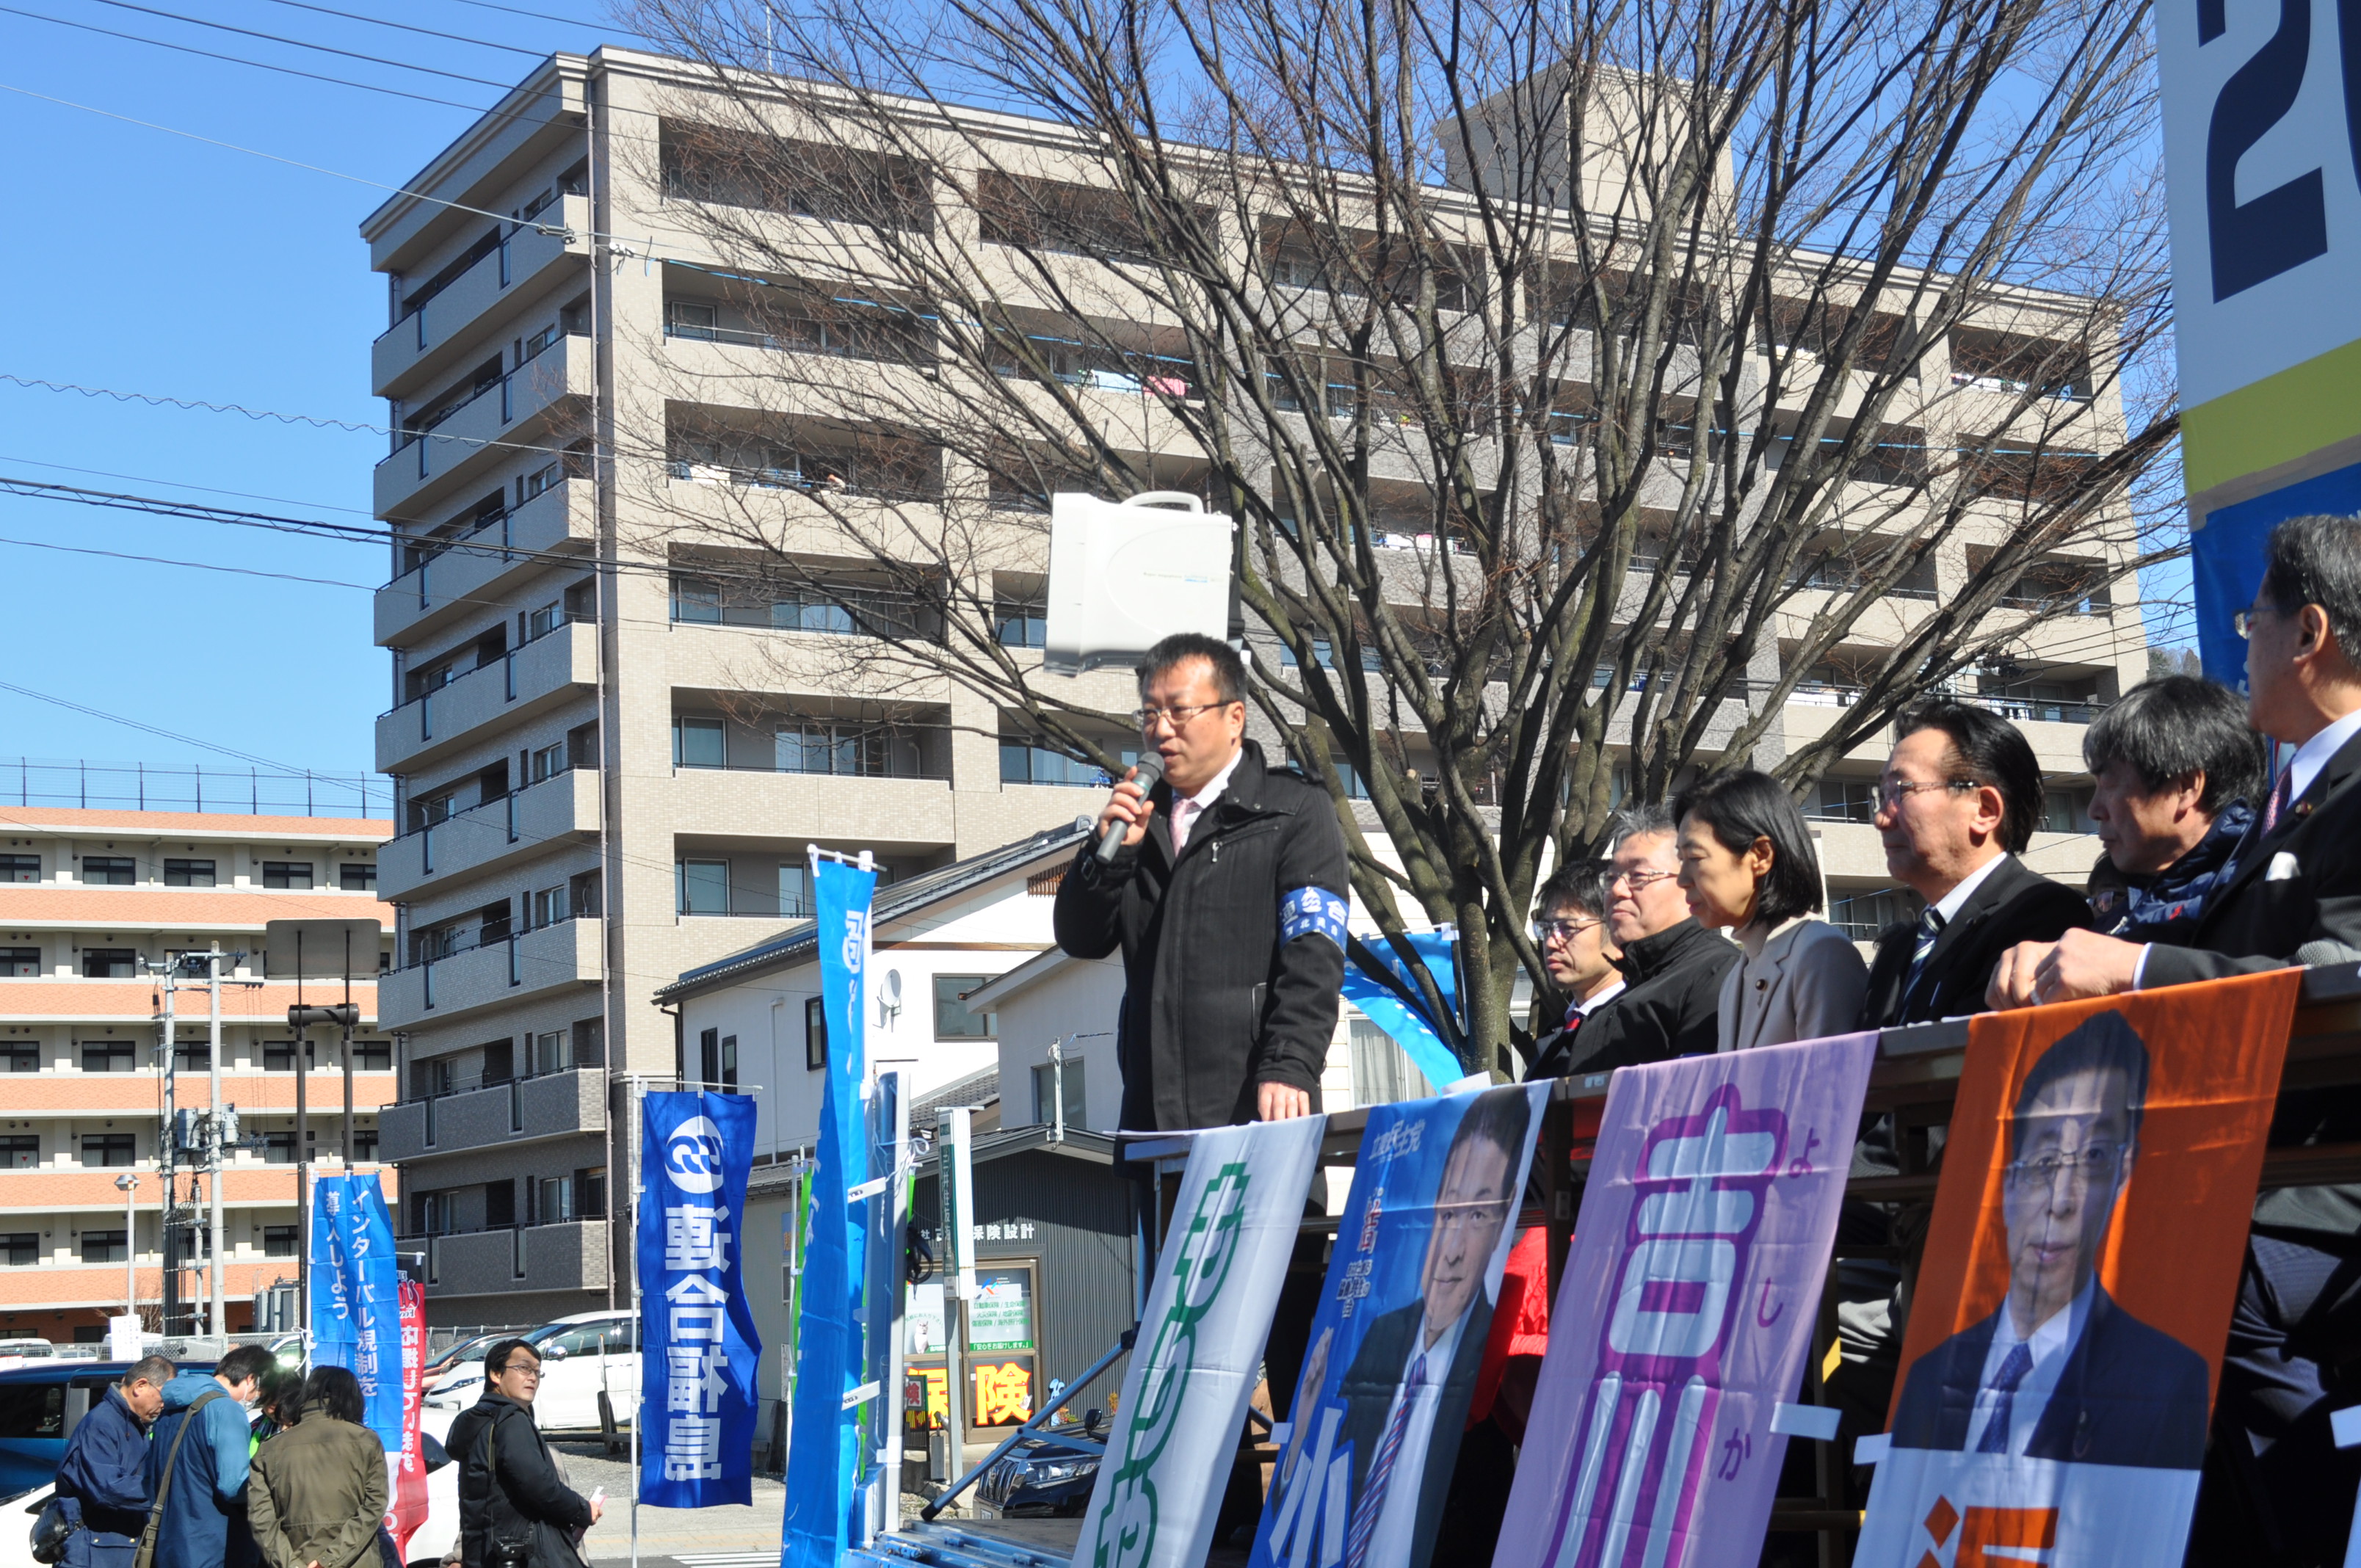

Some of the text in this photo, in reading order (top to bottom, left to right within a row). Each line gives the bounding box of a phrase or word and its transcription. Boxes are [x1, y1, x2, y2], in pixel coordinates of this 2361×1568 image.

[325, 1191, 350, 1321] 導入しよう
[352, 1189, 379, 1397] インターバル規制を
